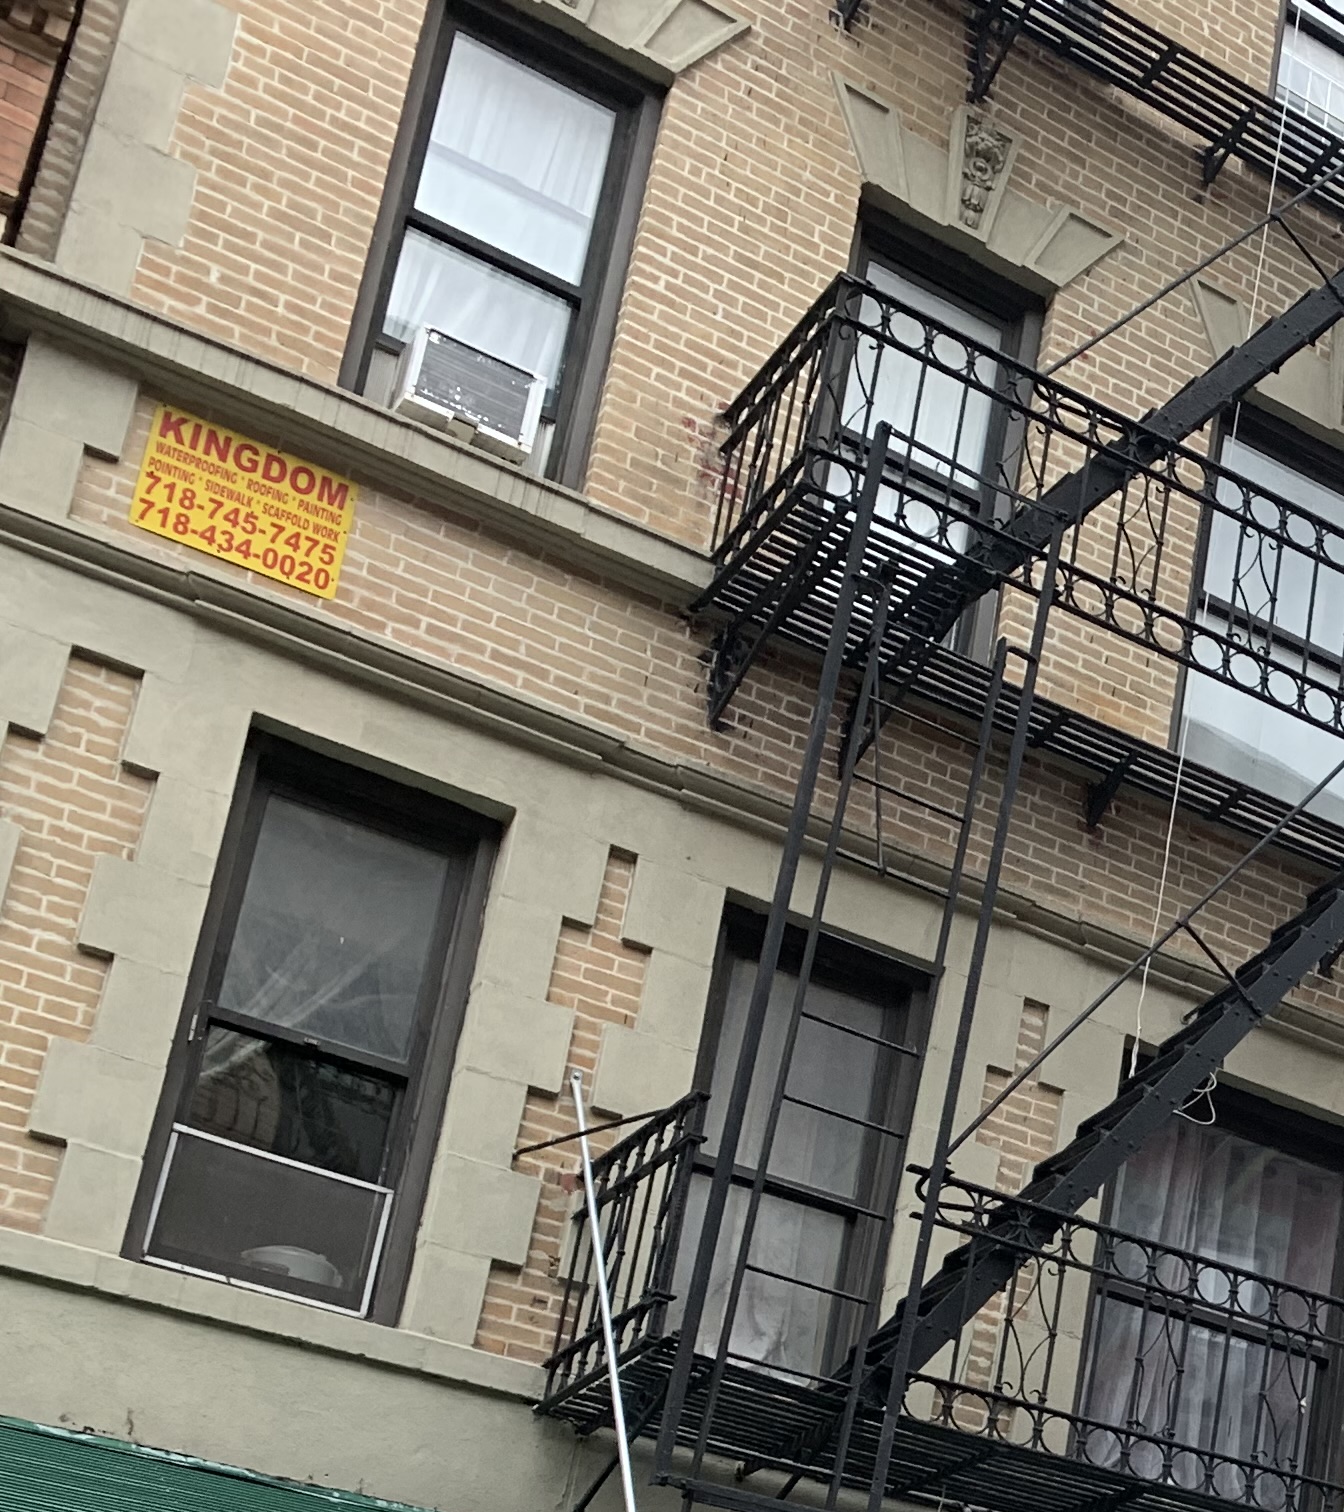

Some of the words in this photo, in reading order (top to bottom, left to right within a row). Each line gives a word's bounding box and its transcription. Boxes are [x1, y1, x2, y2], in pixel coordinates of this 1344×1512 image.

[148, 456, 196, 484] POINTING
[204, 479, 254, 508] SIDEWALK
[262, 502, 310, 530] SCAFFOLD
[312, 523, 341, 543] WORK
[155, 440, 238, 484] WATERPROOFING
[246, 479, 289, 505] ROOFING
[297, 500, 343, 527] PAINTING
[159, 411, 349, 511] KINGDOM
[138, 498, 331, 591] 718-434-0020
[146, 473, 336, 566] 718-745-7475
